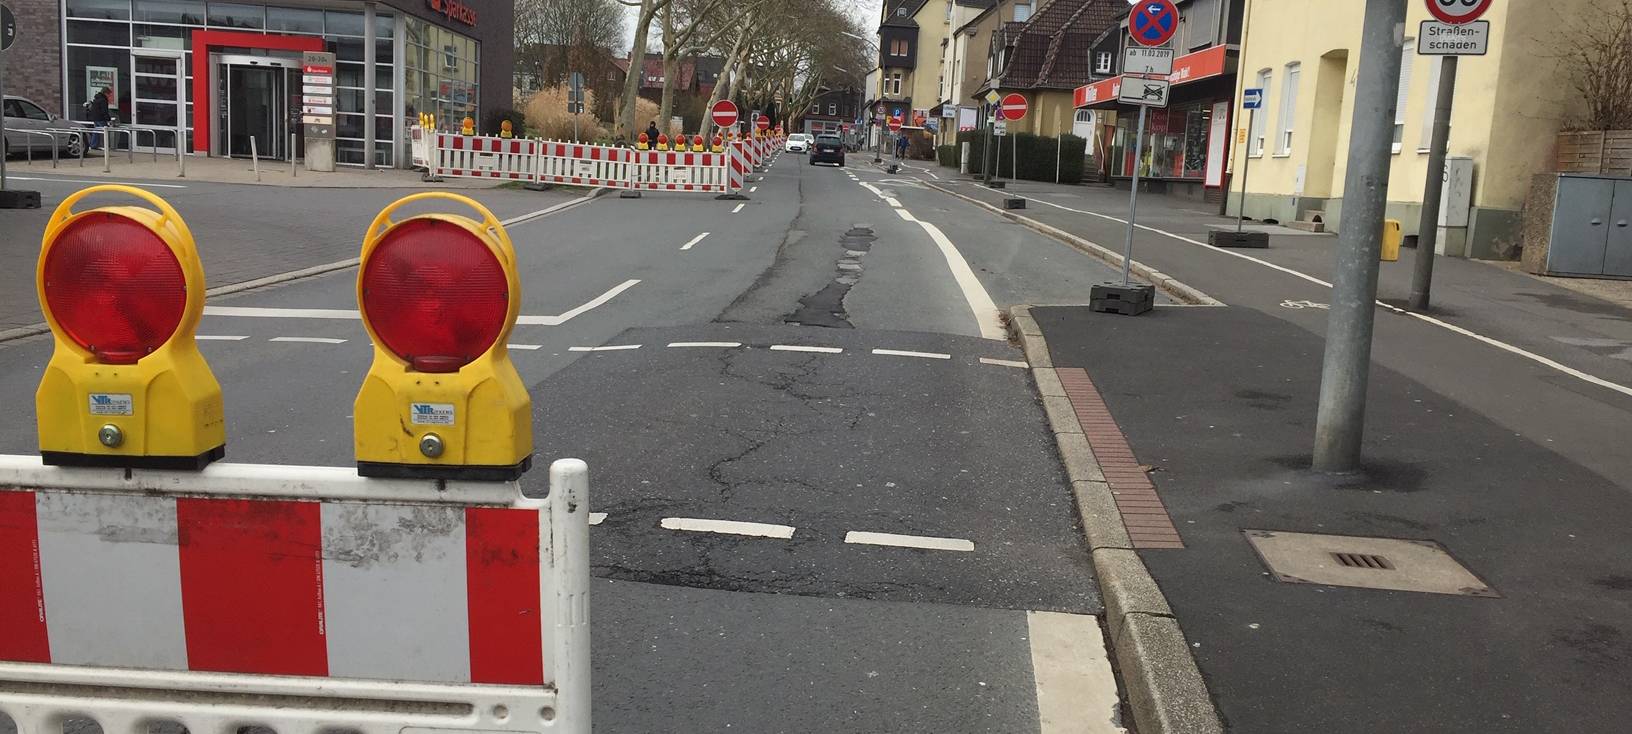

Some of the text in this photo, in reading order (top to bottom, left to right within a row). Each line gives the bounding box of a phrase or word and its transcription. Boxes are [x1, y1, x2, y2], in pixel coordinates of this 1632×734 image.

[1429, 26, 1480, 36] Straßen-
[1130, 49, 1170, 58] ab 11.03.2019
